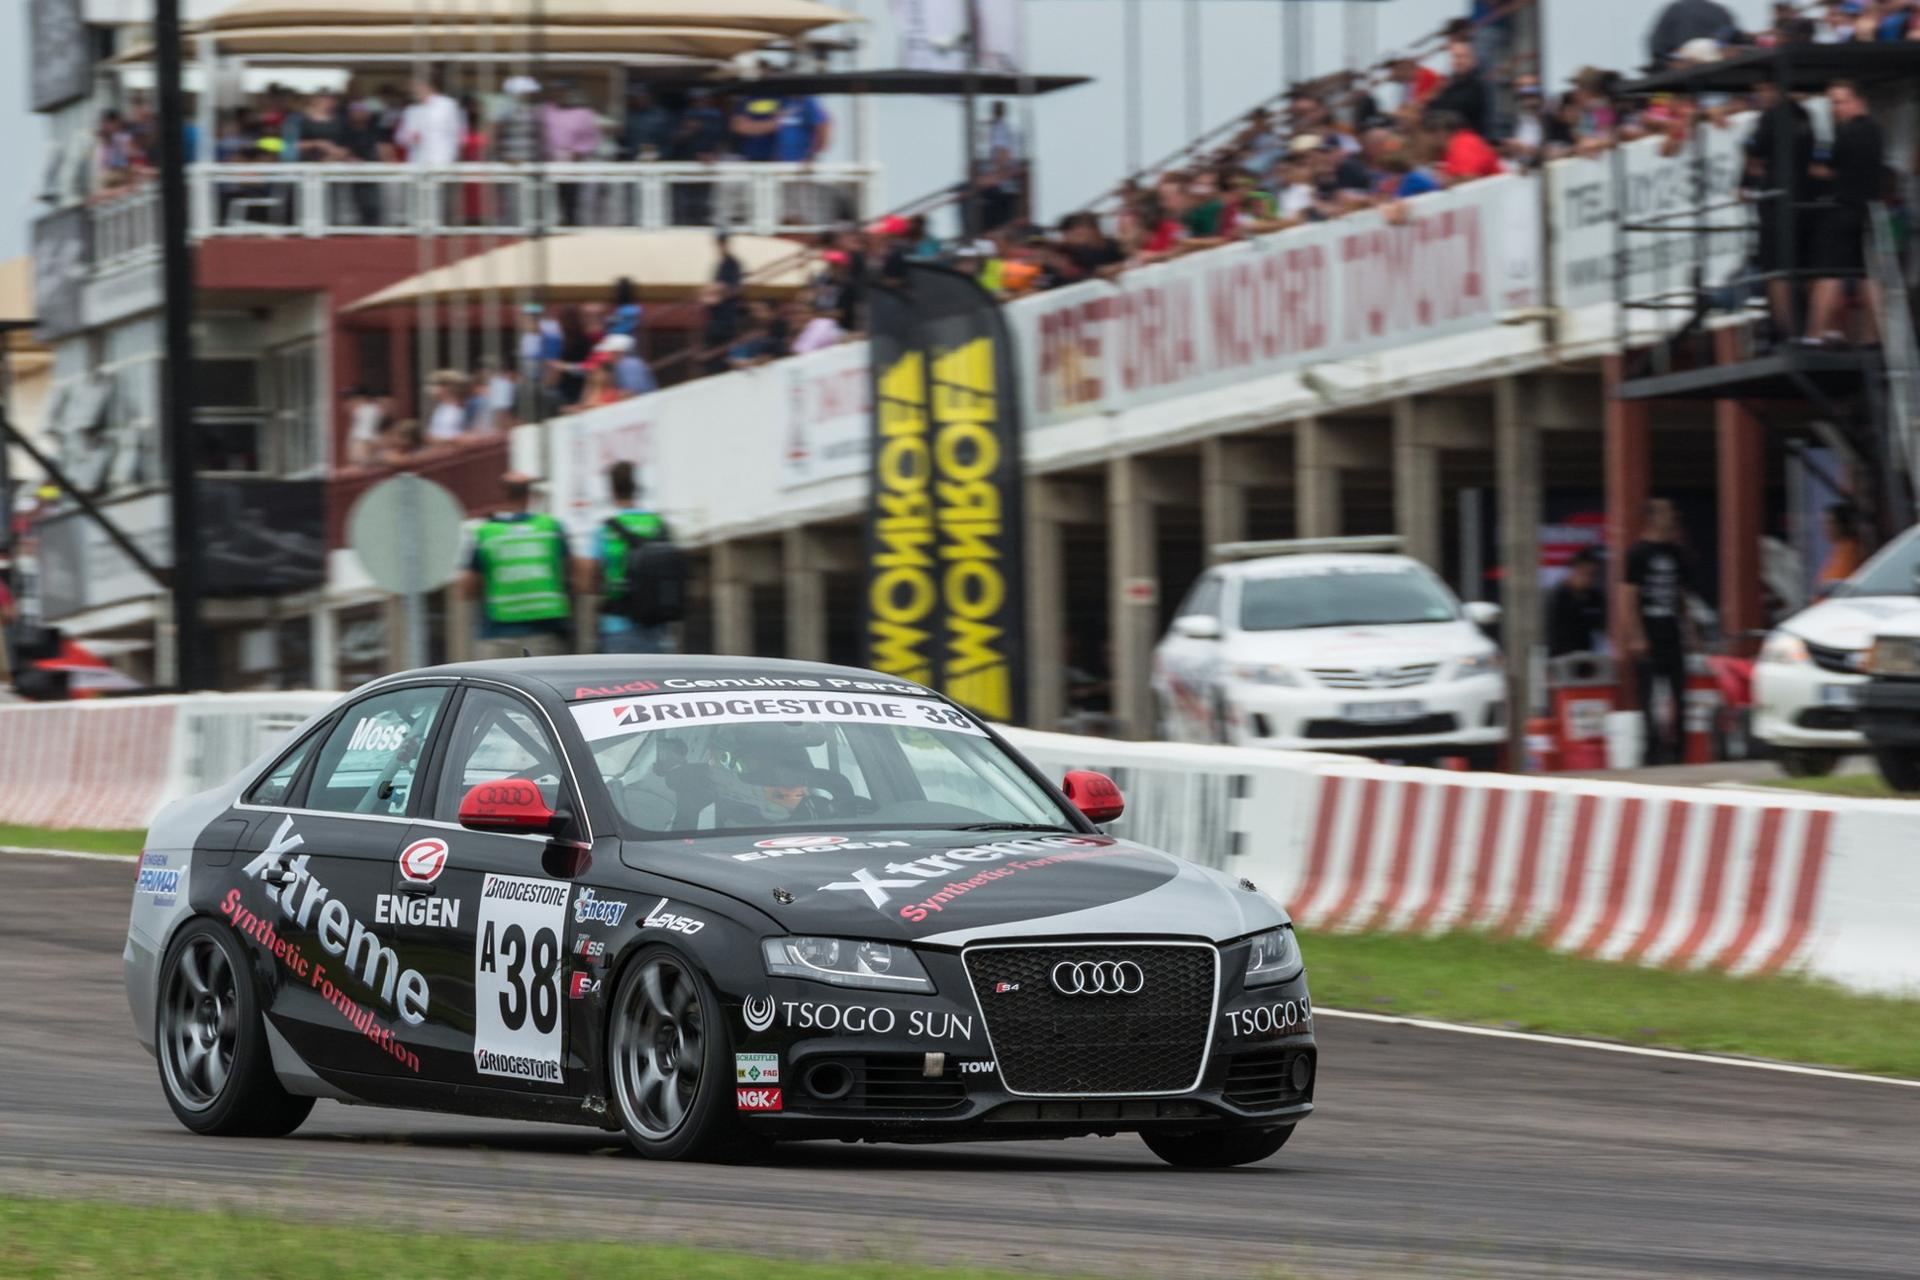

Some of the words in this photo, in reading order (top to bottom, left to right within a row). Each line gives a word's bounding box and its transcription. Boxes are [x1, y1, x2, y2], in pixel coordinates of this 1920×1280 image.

[575, 679, 660, 699] Audi
[663, 676, 821, 690] Genuine
[826, 678, 928, 695] Parts
[613, 699, 907, 727] BRIDGESTONE
[916, 704, 971, 729] 38
[732, 840, 911, 862] ENGEN
[484, 876, 567, 907] BRIDGESTONE
[900, 867, 1015, 923] Synthetic
[375, 894, 461, 928] ENGEN
[220, 888, 308, 977] Synthetic
[312, 963, 420, 1073] Formulation
[782, 1001, 896, 1033] TSOGO
[907, 1010, 973, 1041] SUN
[1225, 1000, 1298, 1037] TSOGO
[478, 1049, 560, 1080] BRIDGESTONE
[763, 1069, 778, 1077] FAG
[959, 1060, 995, 1074] TOW
[737, 1090, 770, 1107] NGK
